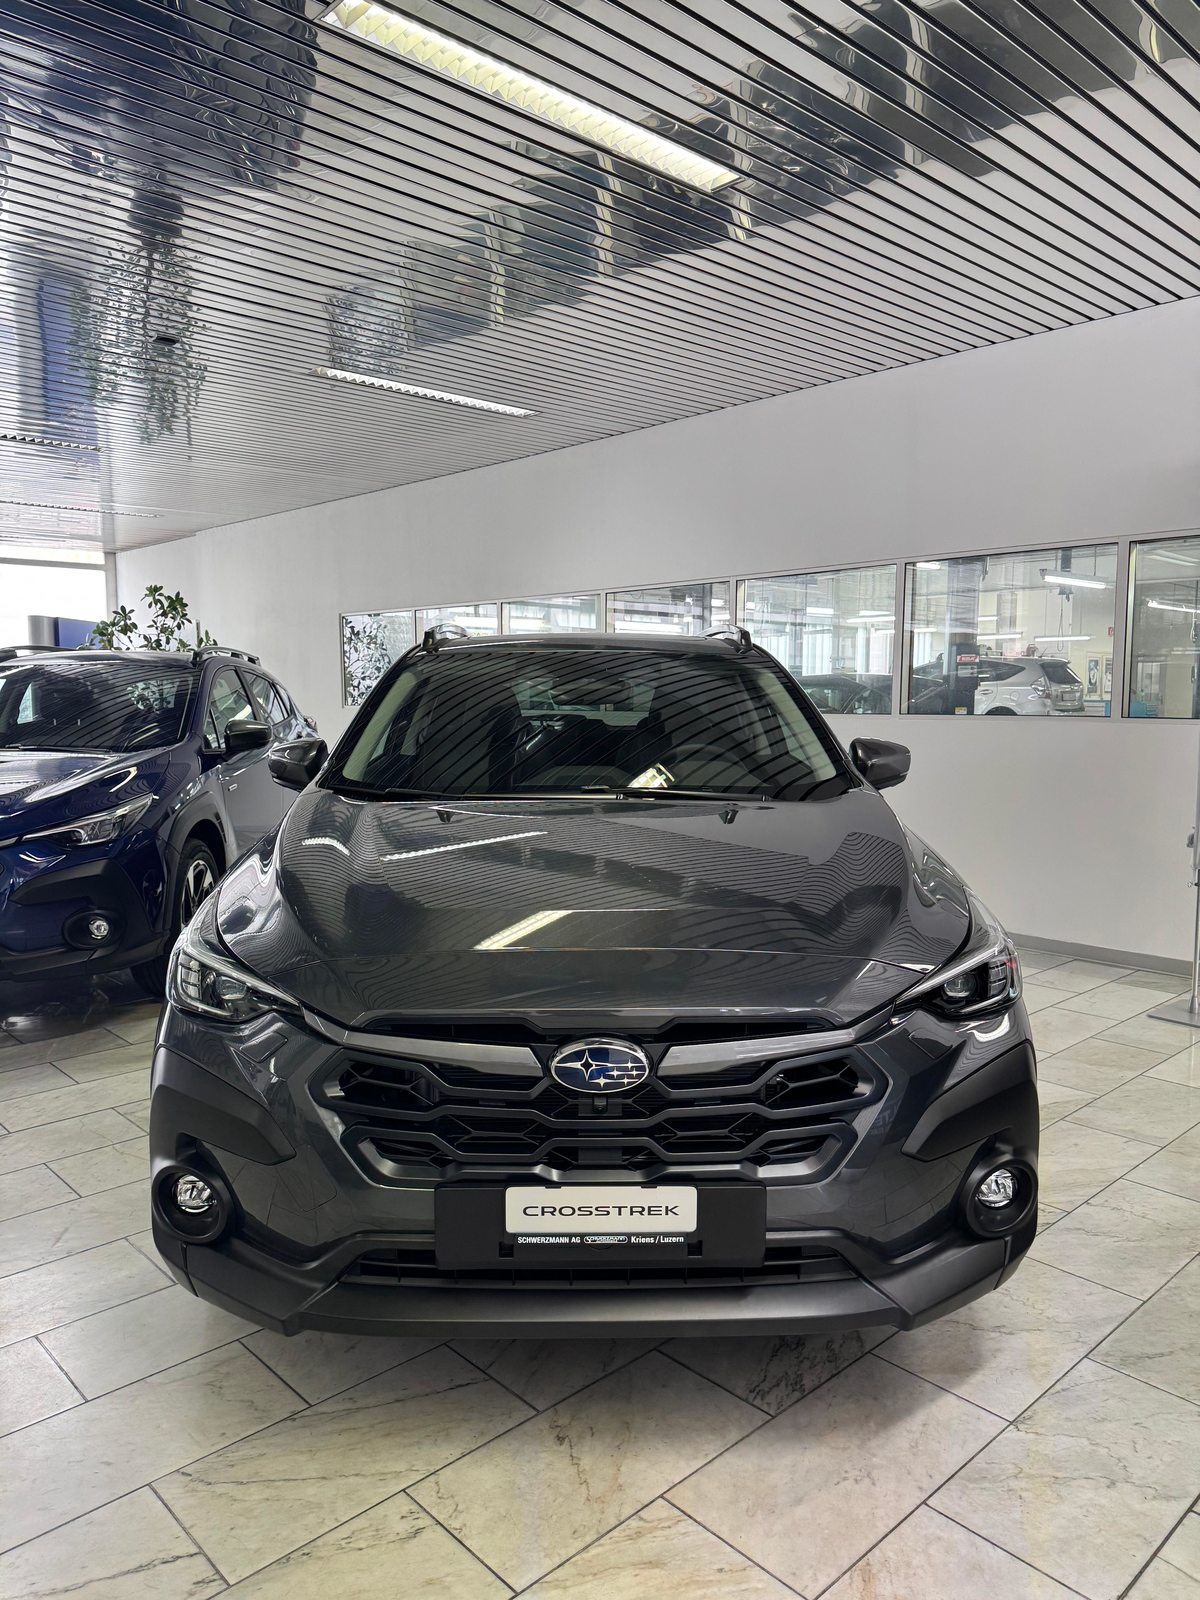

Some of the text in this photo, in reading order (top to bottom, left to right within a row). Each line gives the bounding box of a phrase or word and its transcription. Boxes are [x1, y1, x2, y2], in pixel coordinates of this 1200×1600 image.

[522, 1205, 680, 1217] CROSSTREK
[517, 1236, 569, 1244] SCHWERZMANN
[571, 1236, 581, 1244] AG
[660, 1235, 684, 1243] Luzern
